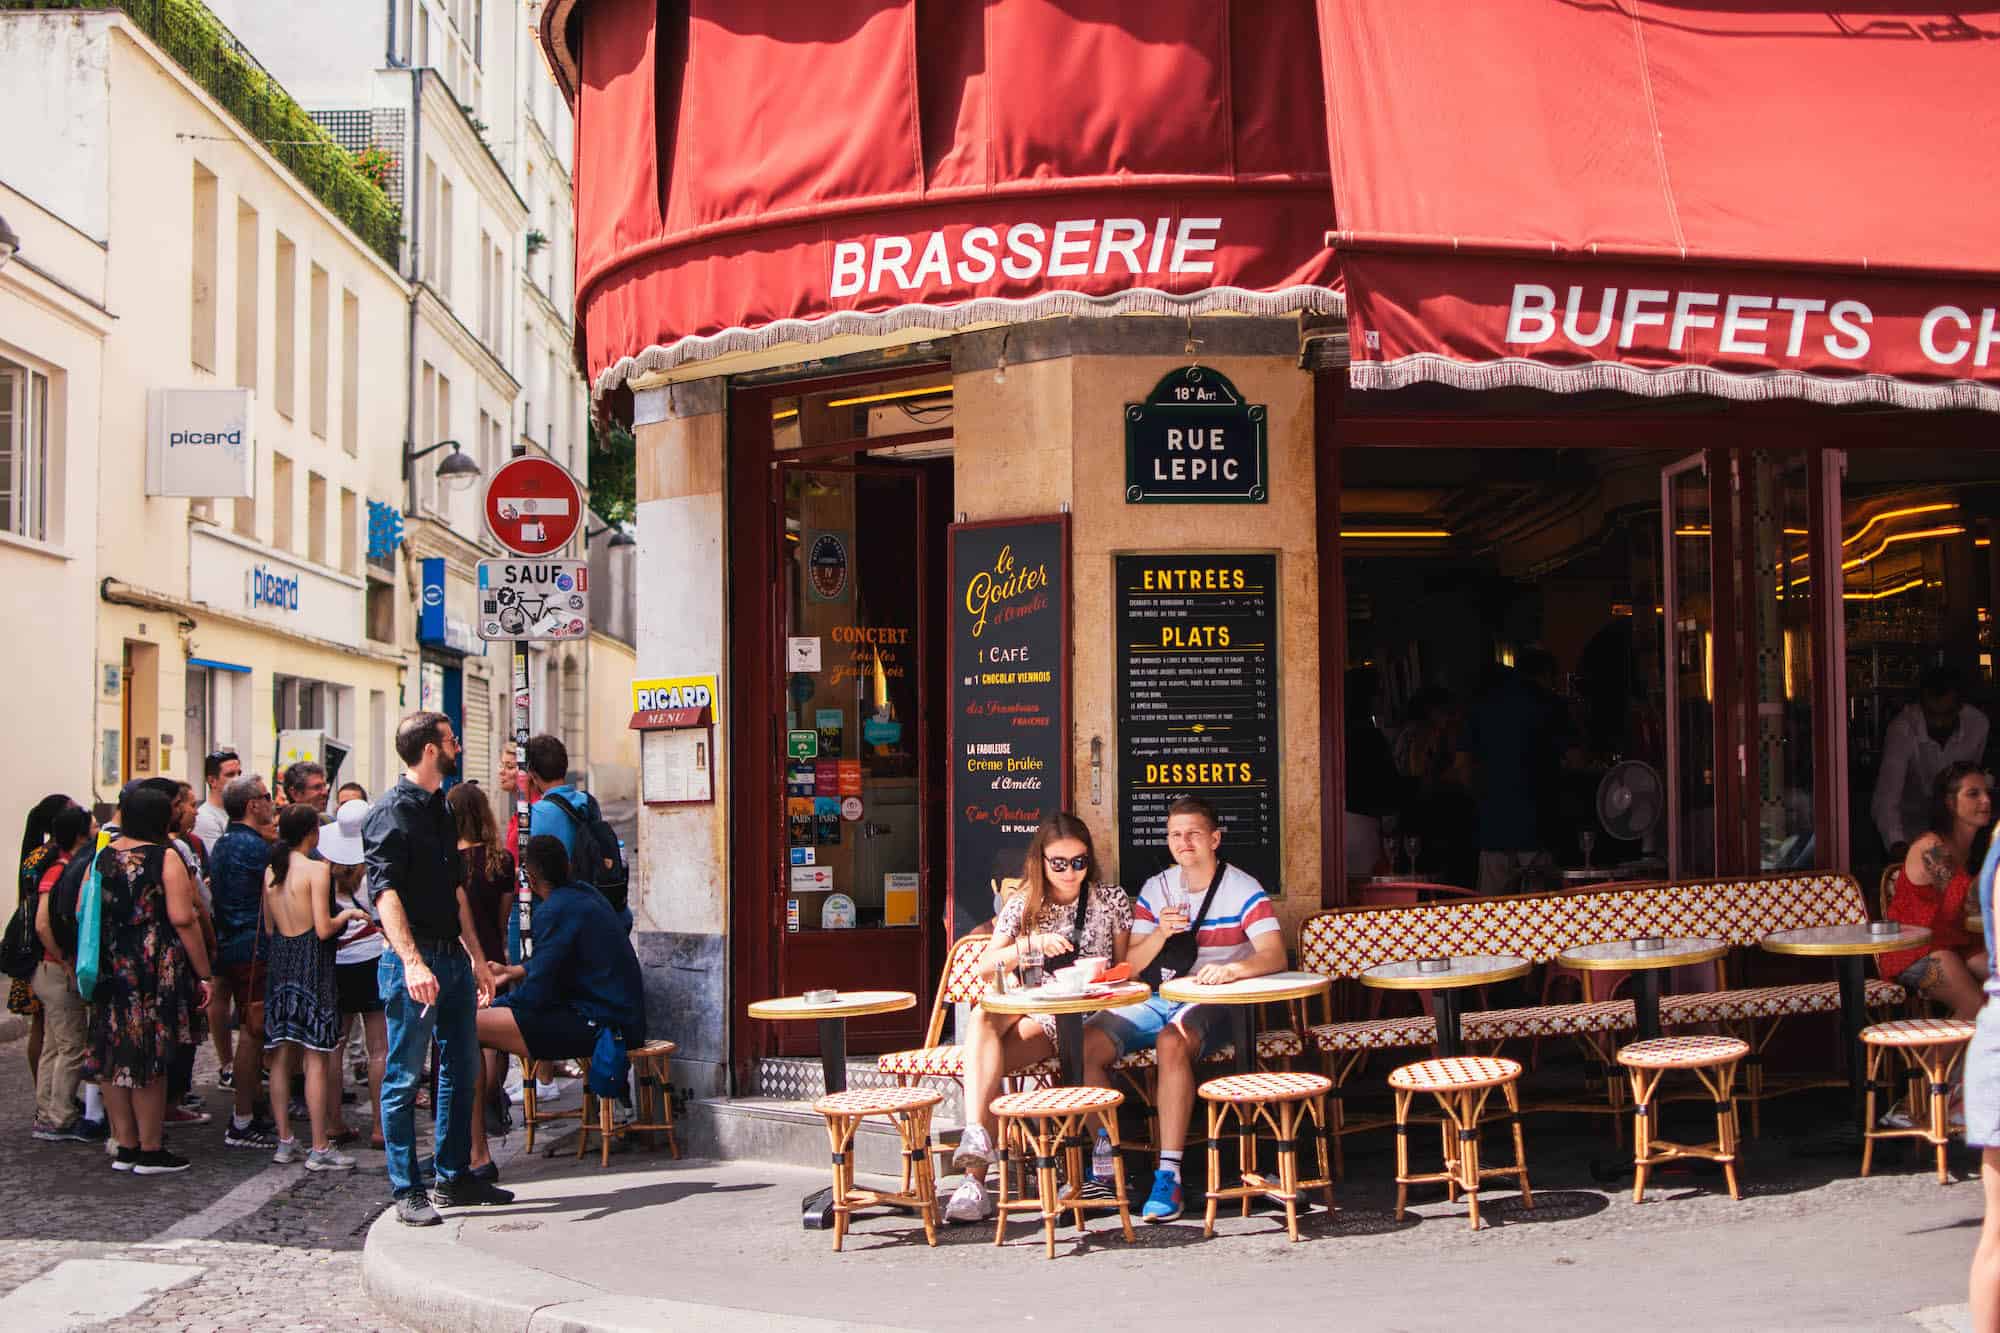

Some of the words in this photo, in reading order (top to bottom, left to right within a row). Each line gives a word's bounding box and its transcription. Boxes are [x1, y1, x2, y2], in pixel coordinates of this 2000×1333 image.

[830, 217, 1222, 298] BRASSERIE
[1505, 283, 1875, 361] BUFFETS
[169, 430, 242, 448] picard
[1167, 428, 1226, 451] RUE
[1153, 458, 1240, 481] LEPIC
[995, 545, 1014, 573] le
[504, 564, 564, 584] SAUF
[253, 563, 299, 611] picard
[831, 627, 909, 645] CONCERT
[1161, 626, 1231, 648] PLATS
[978, 650, 984, 663] 1
[990, 646, 1030, 662] CAFÉ
[982, 672, 1016, 686] CHOCOLAT
[1018, 671, 1051, 684] VIENNOIS
[637, 685, 711, 710] RICARD
[648, 712, 686, 723] MENU
[967, 743, 976, 755] LA
[977, 743, 1011, 755] FABULEUSE
[1146, 763, 1252, 784] DESSERTS
[1001, 824, 1012, 833] EN
